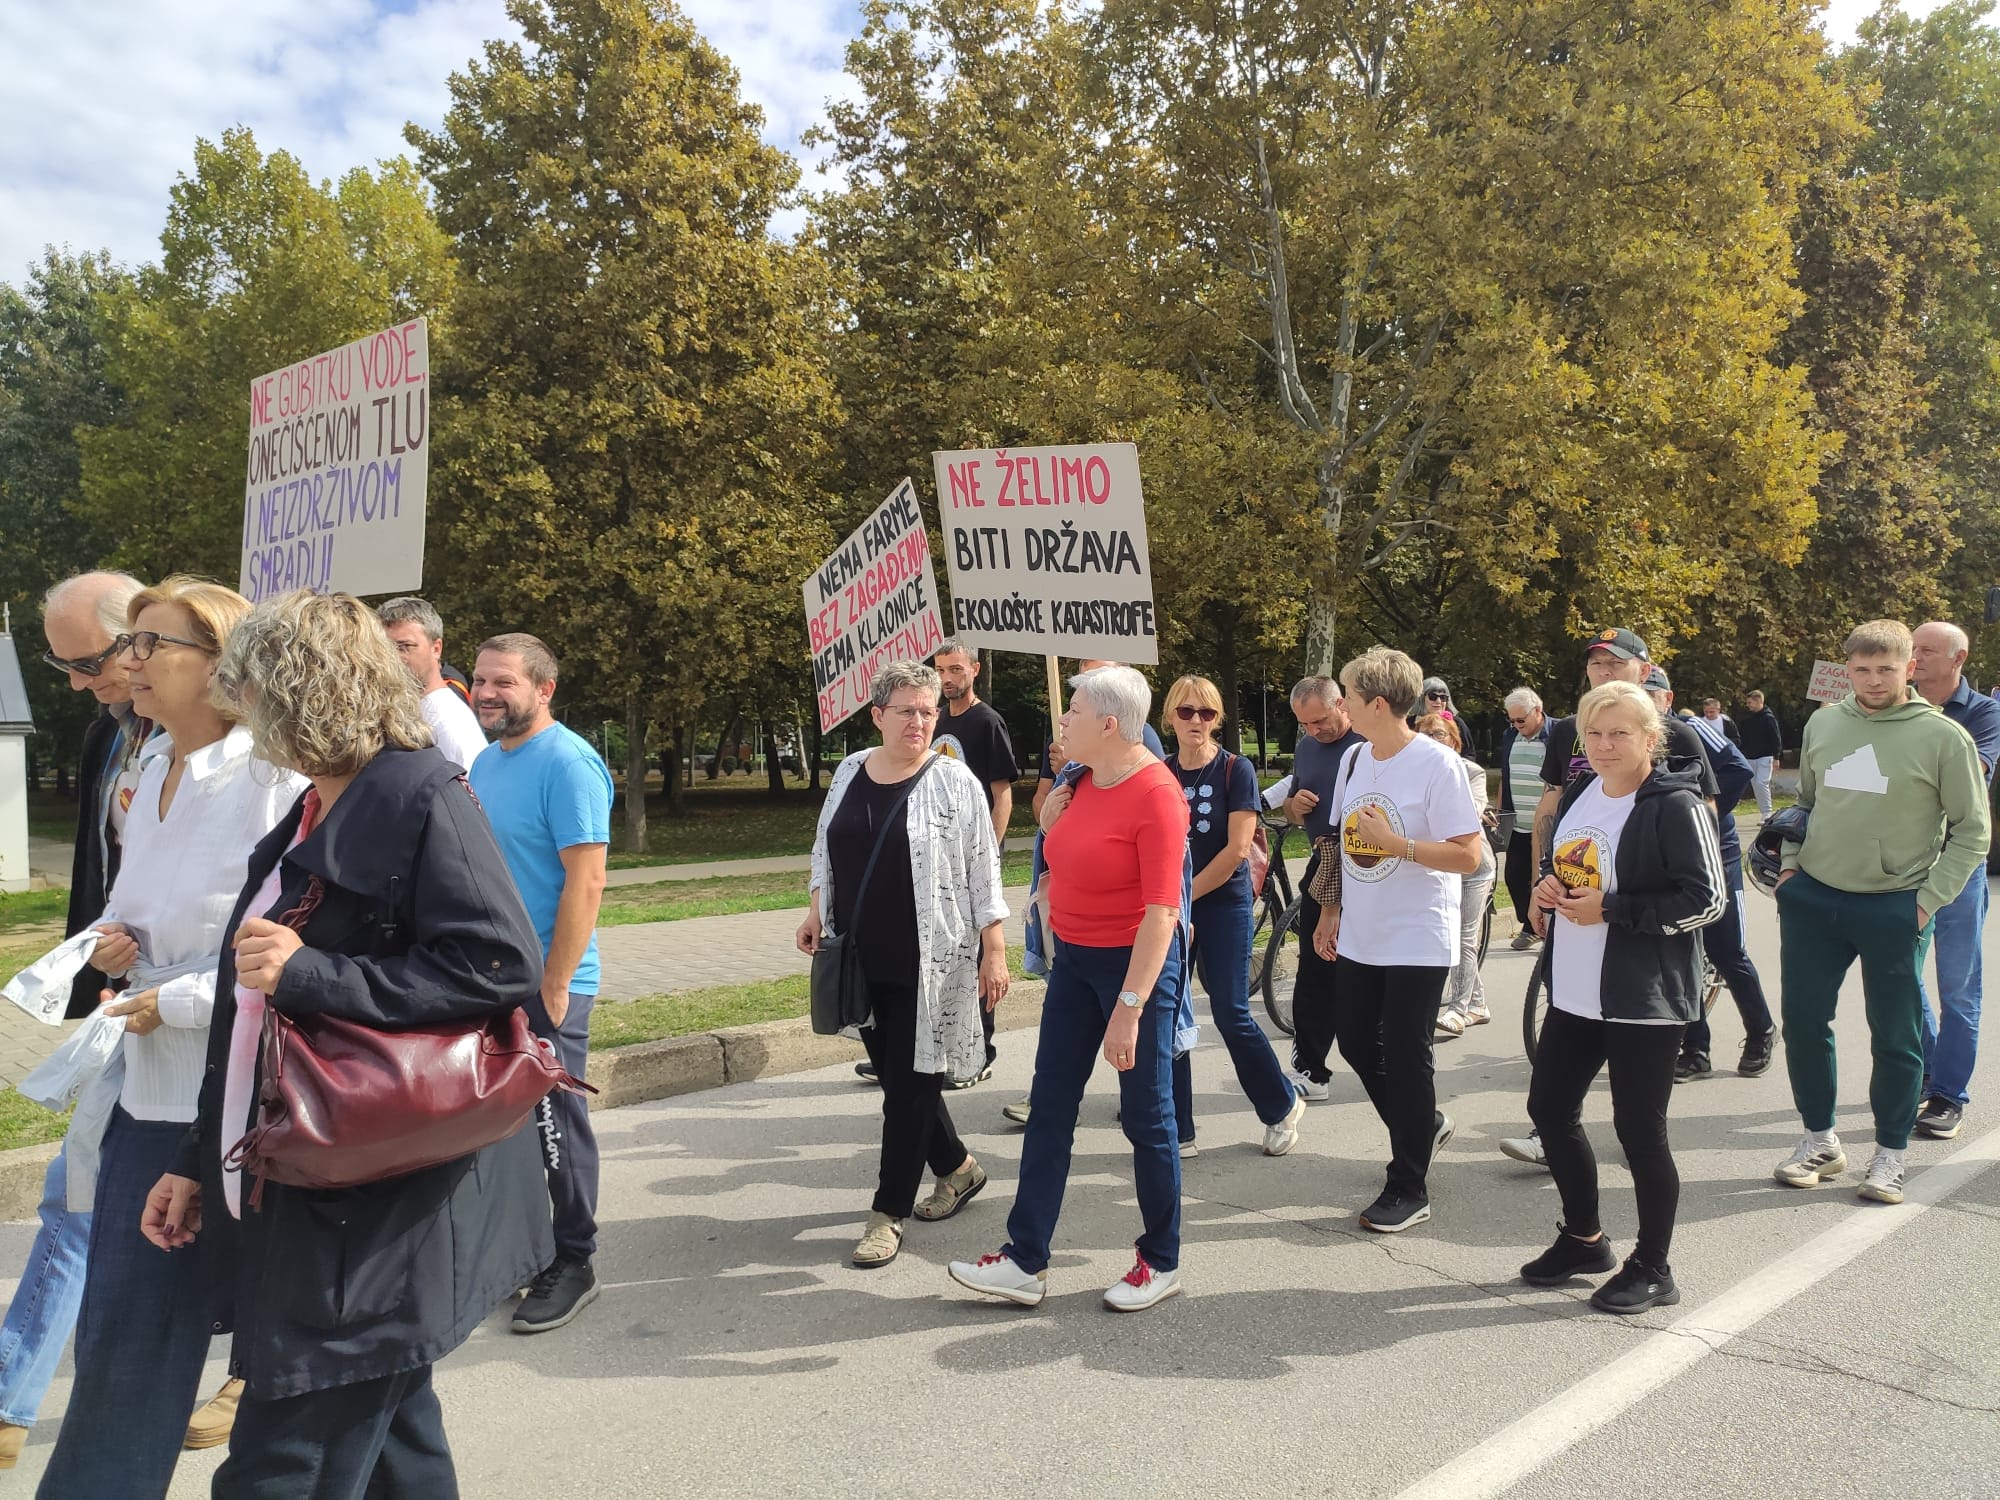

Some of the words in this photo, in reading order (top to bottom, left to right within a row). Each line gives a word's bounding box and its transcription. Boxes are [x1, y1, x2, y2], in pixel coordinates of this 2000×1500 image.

[251, 377, 274, 428] NE
[279, 350, 351, 417] GUBITKU
[359, 324, 425, 392] VODE,
[250, 402, 360, 486] ONEČIŠĆENOM
[373, 388, 425, 457] TLU
[245, 496, 252, 549] I
[257, 457, 402, 546] NEIZDRŽIVOM
[948, 460, 986, 508] NE
[996, 450, 1110, 508] ŽELIMO
[246, 534, 334, 603] SMRADU!
[818, 539, 863, 603] NEMA
[862, 484, 919, 561] FARME
[954, 527, 1011, 571] BITI
[1025, 519, 1141, 574] DRŽAVA
[809, 600, 842, 654] BEZ
[845, 527, 928, 625] ZAGAĐENJA
[954, 591, 1045, 634] EKOLOŠKE
[1051, 600, 1155, 636] KATASTROFE
[813, 637, 855, 692] NEMA
[857, 573, 927, 657] KLAONICE
[818, 676, 849, 731] BEZ
[1810, 688, 1840, 700] KARTU
[1815, 678, 1827, 686] NE
[1347, 836, 1384, 852] Apatij
